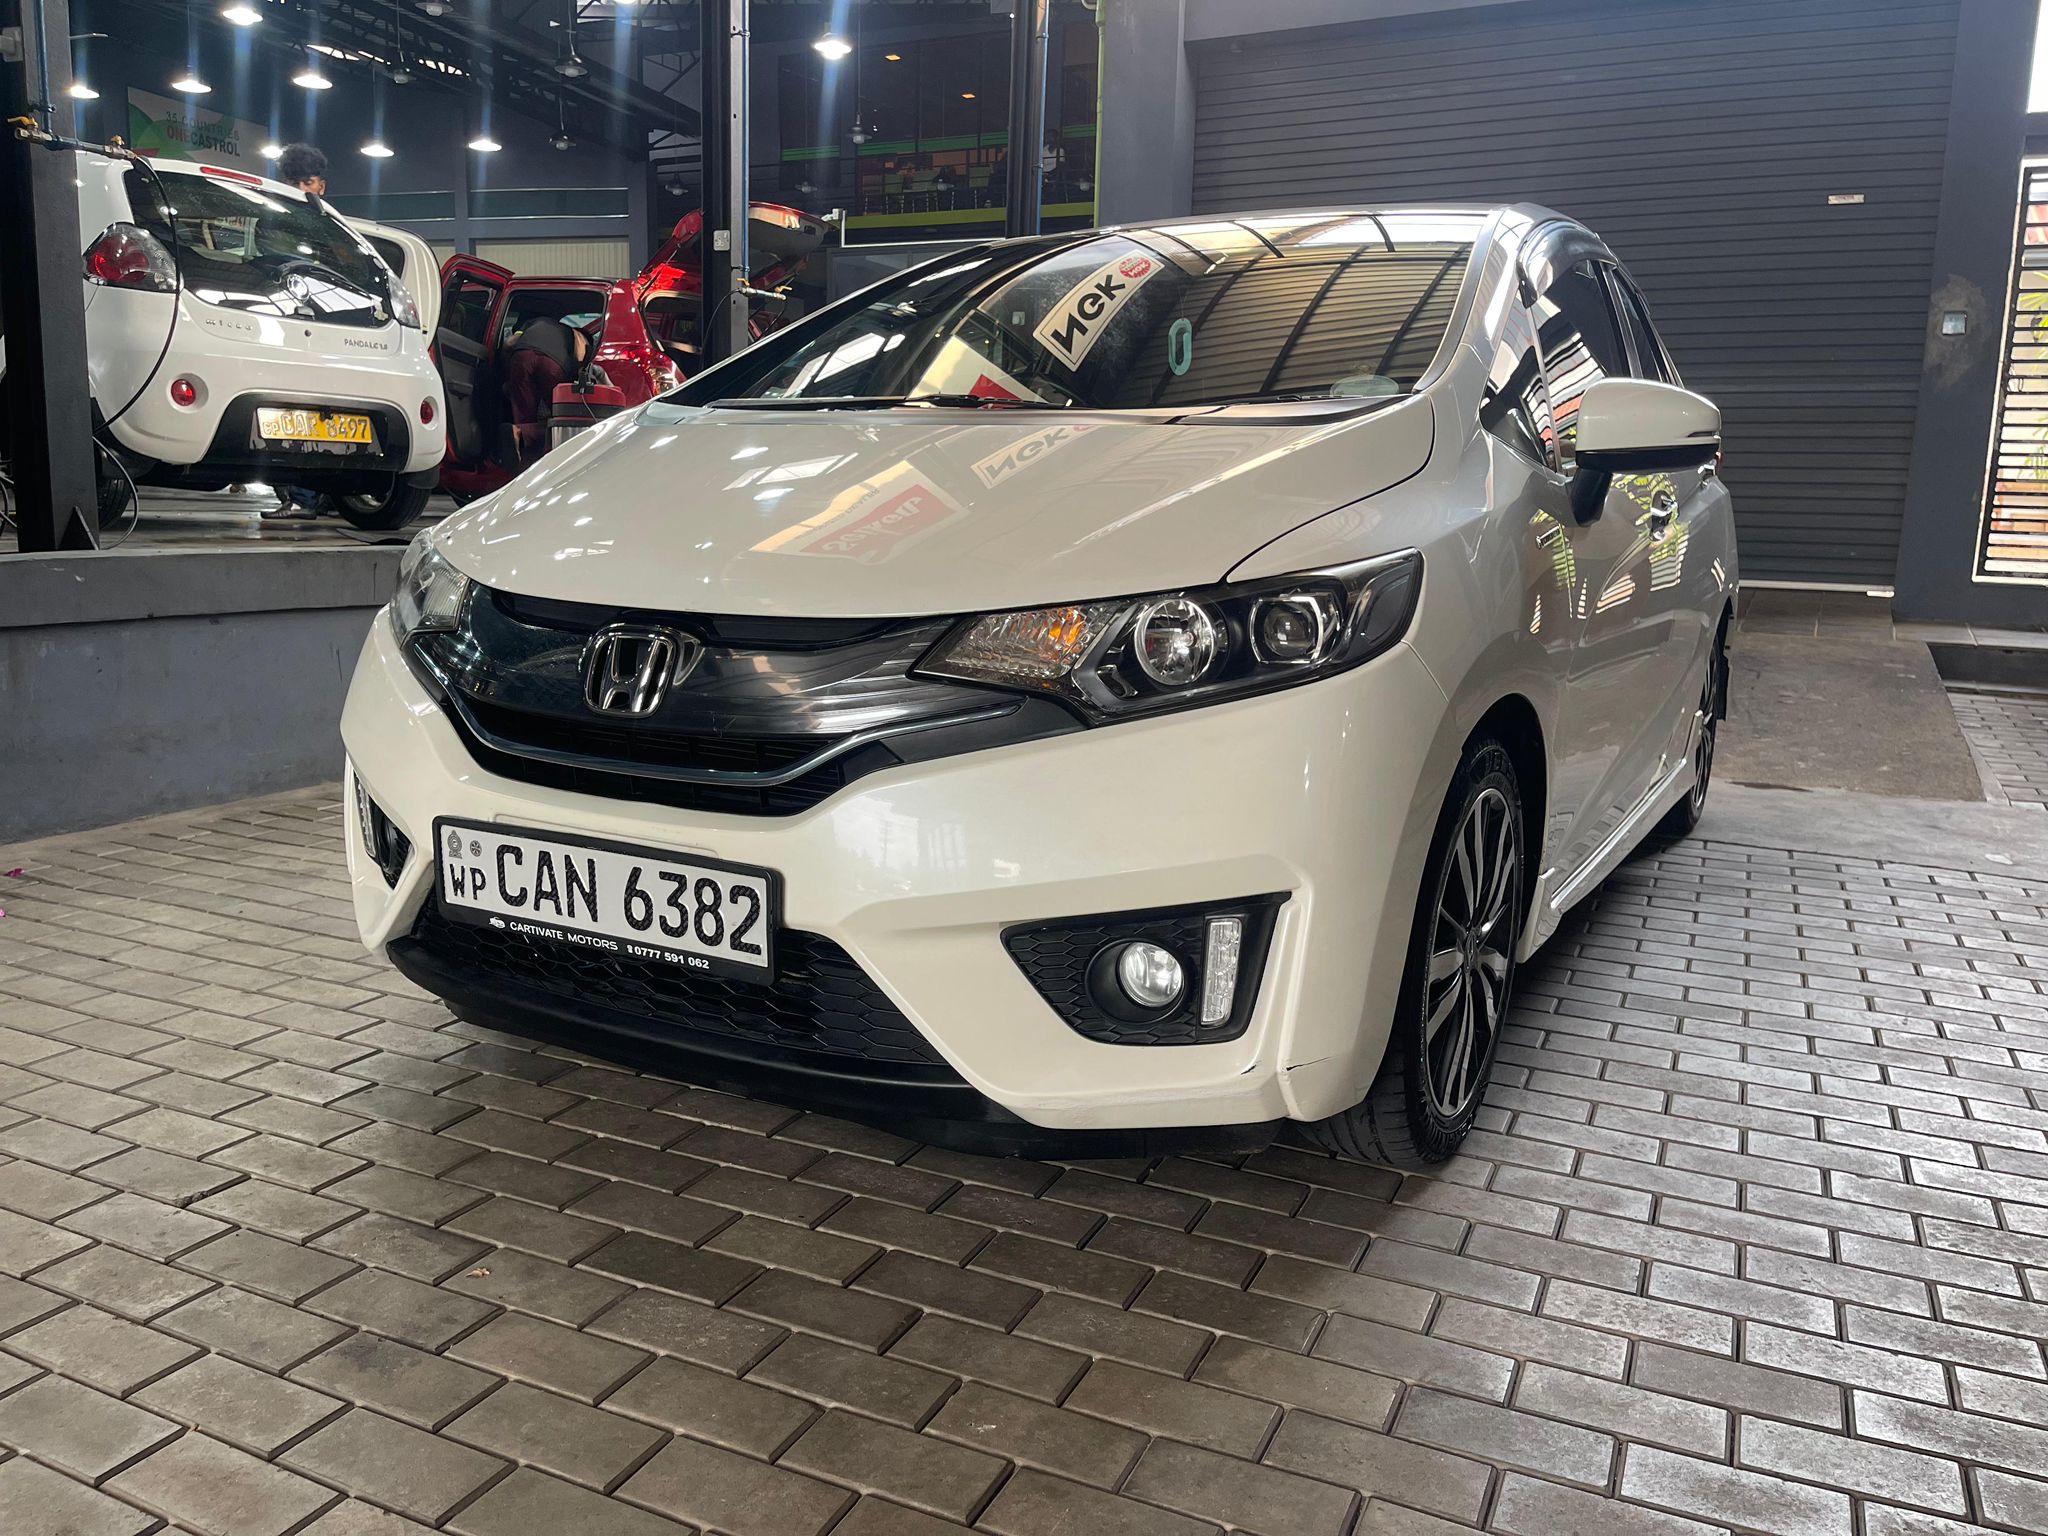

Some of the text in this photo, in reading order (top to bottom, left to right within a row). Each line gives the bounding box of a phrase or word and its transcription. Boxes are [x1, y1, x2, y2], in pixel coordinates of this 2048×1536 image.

[166, 111, 240, 141] 35 COUNTRIES
[280, 413, 319, 437] CAR
[450, 844, 761, 955] WP CAN 6382
[510, 921, 710, 969] CARTIVATE MOTORS 0777 591 062
